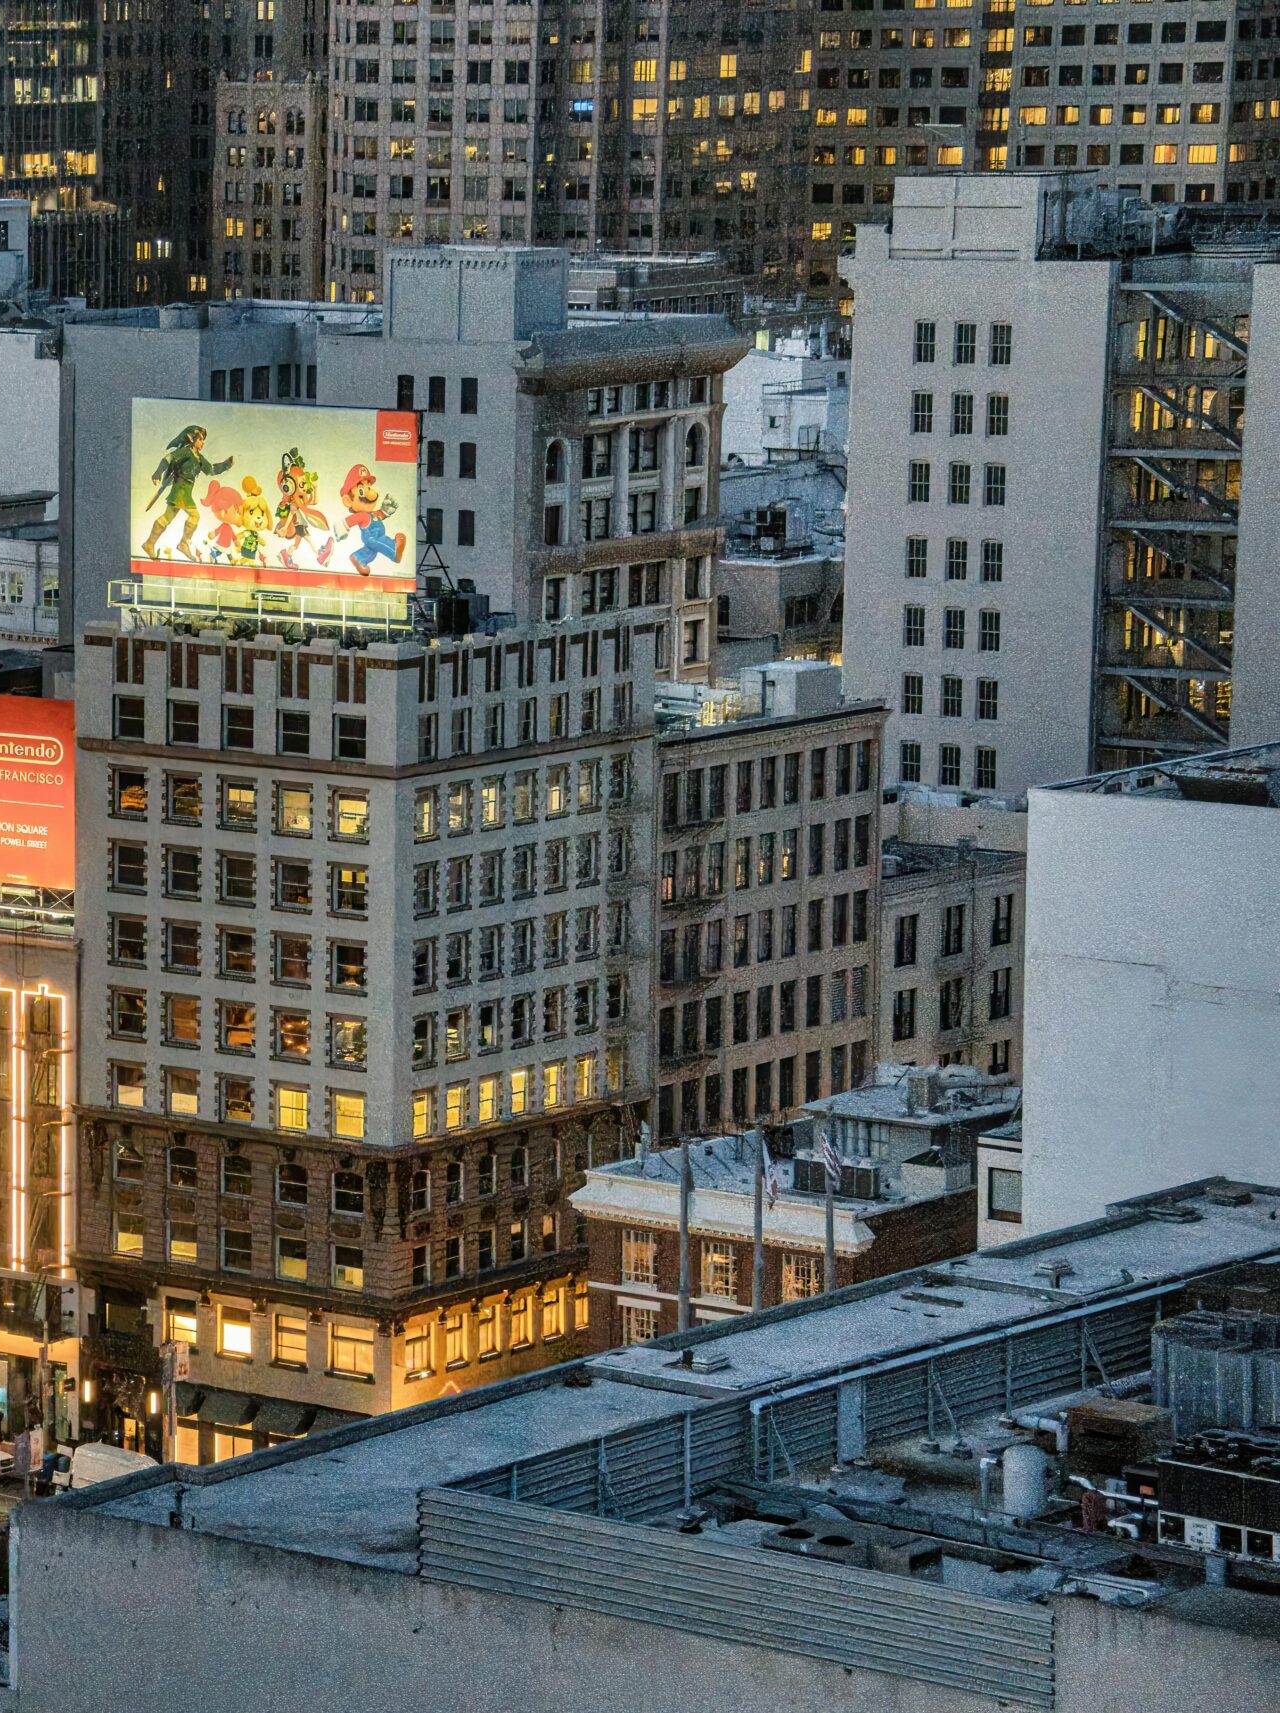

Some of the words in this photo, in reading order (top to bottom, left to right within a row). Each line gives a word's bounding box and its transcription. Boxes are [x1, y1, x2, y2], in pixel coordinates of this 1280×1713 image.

[0, 769, 64, 785] FRANCISCO
[16, 823, 49, 836] SQUARE
[0, 837, 26, 847] POWELL
[26, 839, 47, 849] STREET
